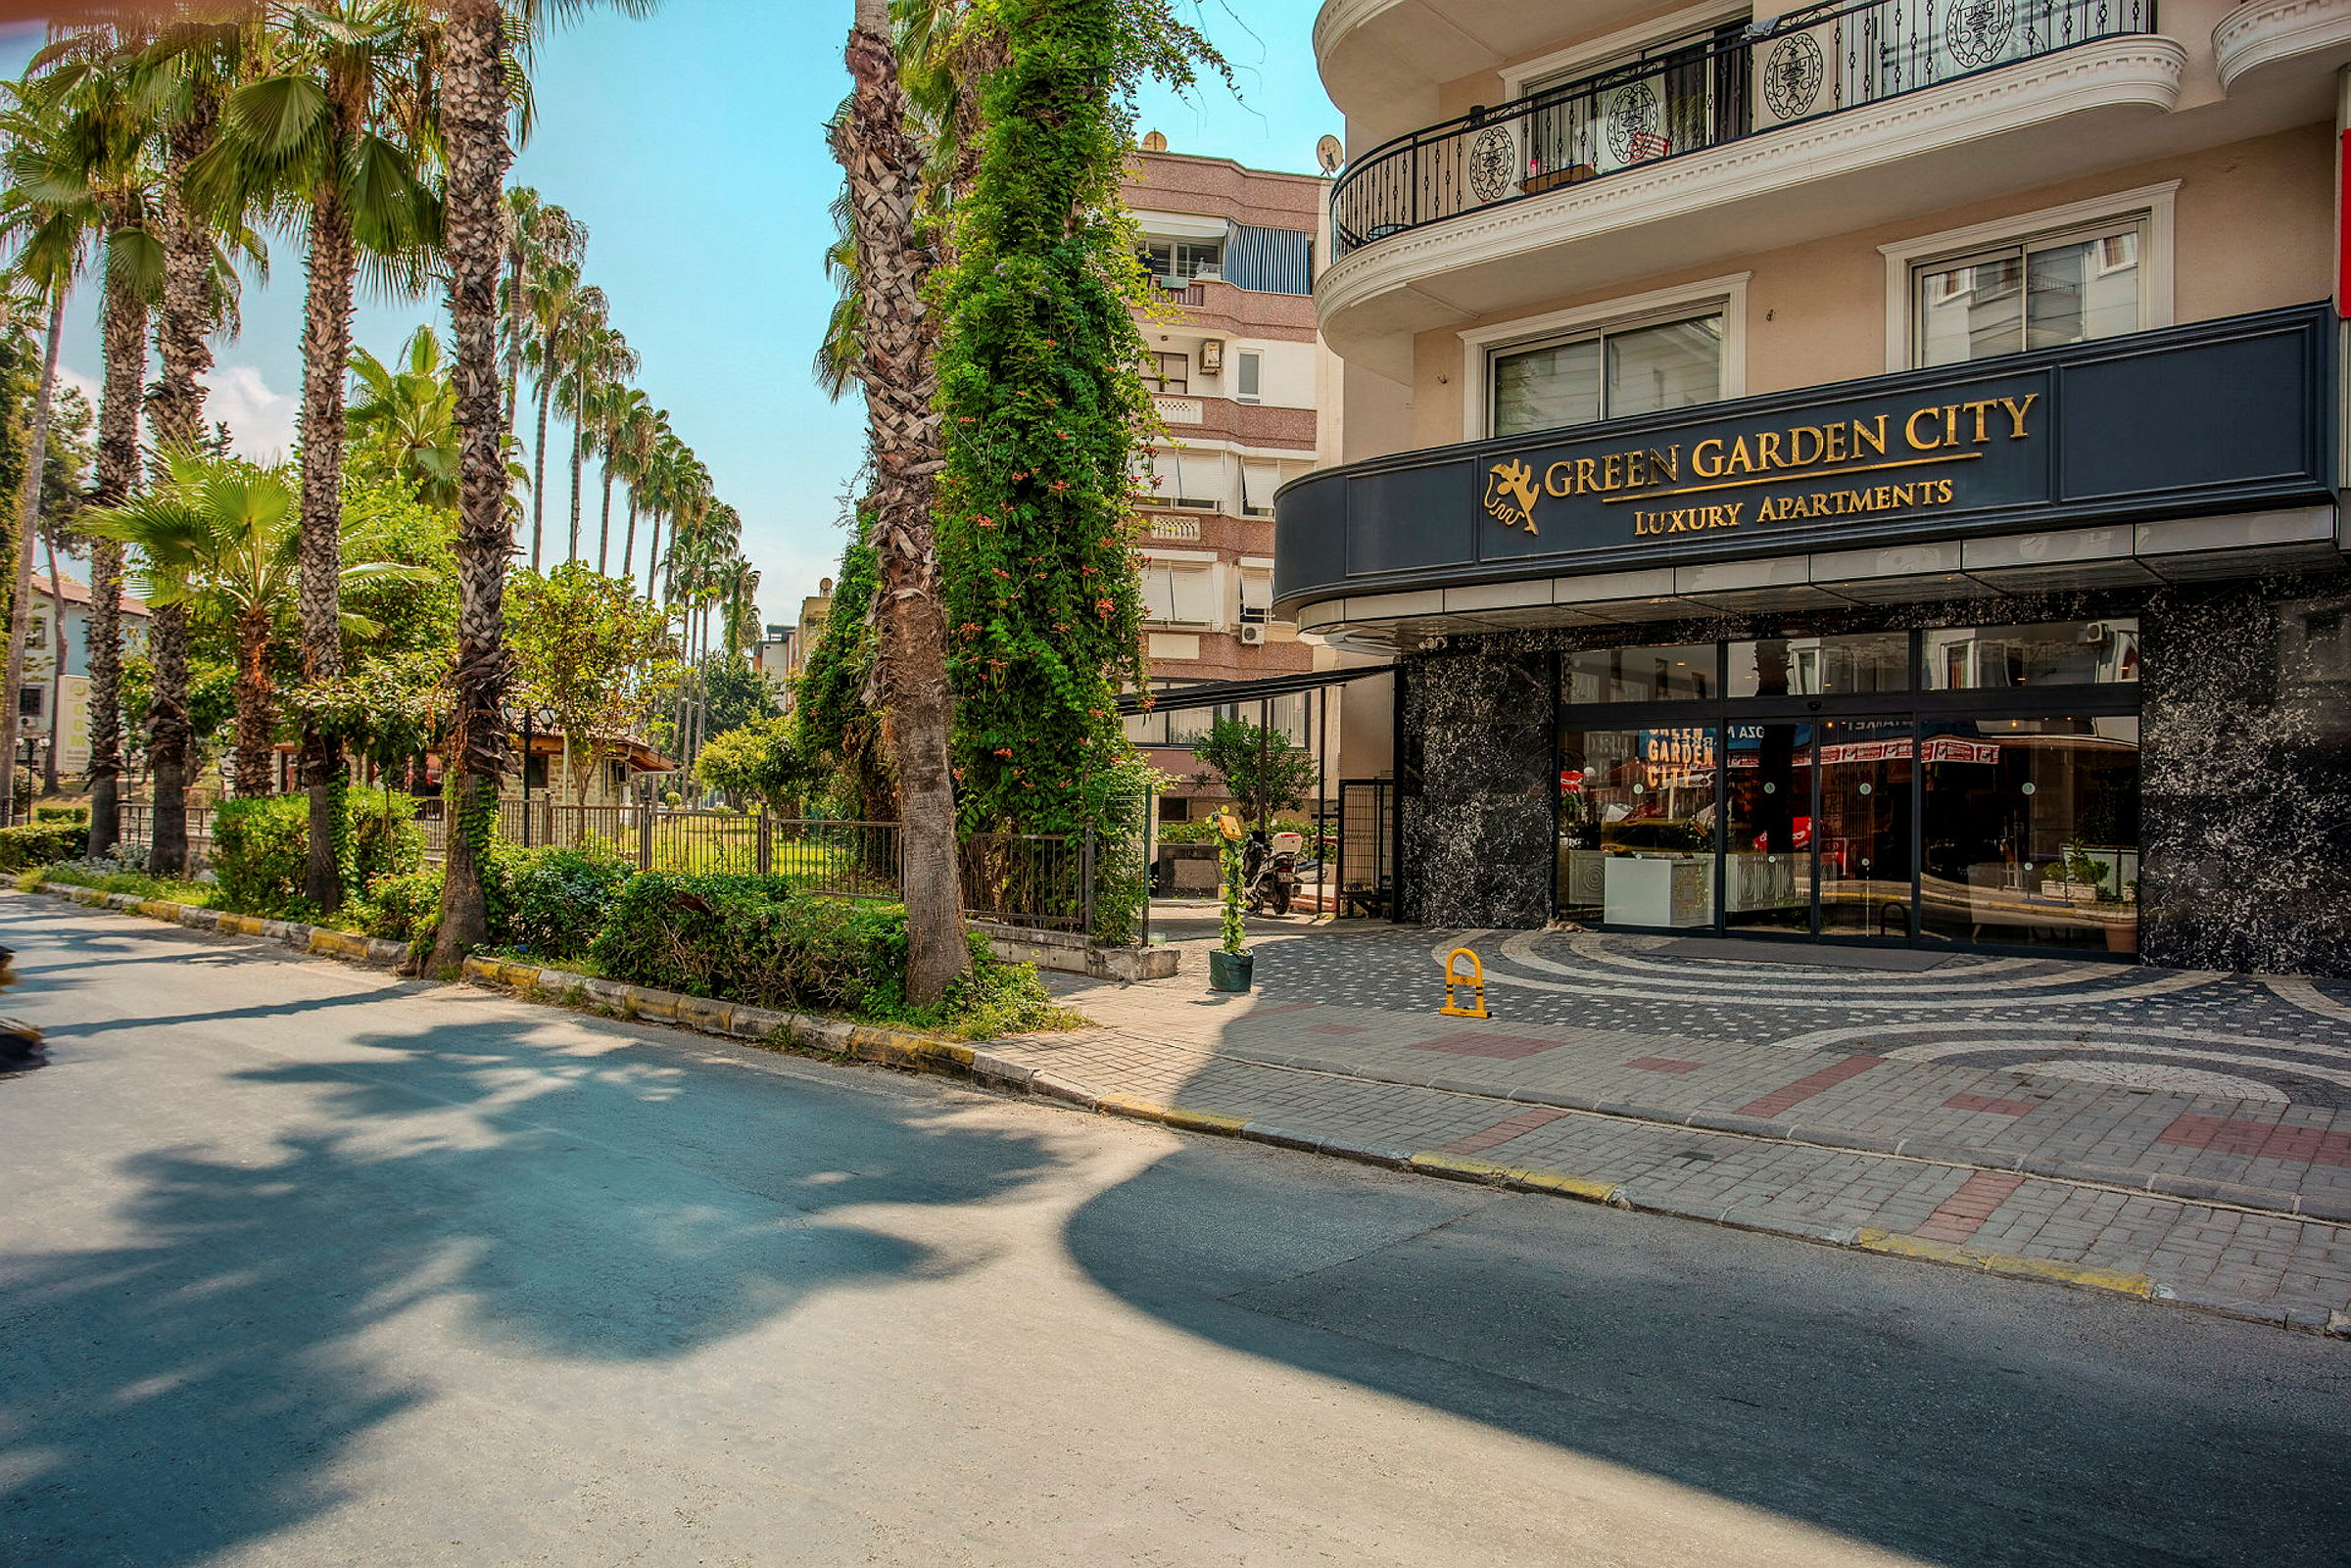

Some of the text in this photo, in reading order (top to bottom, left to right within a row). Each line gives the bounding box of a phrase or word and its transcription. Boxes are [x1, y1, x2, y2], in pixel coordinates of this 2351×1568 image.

[1544, 393, 2039, 498] GREEN GARDEN CITY
[1634, 479, 1953, 536] LUXURY APARTMENTS
[1648, 738, 1713, 767] GARDEN
[1647, 765, 1692, 788] CITY
